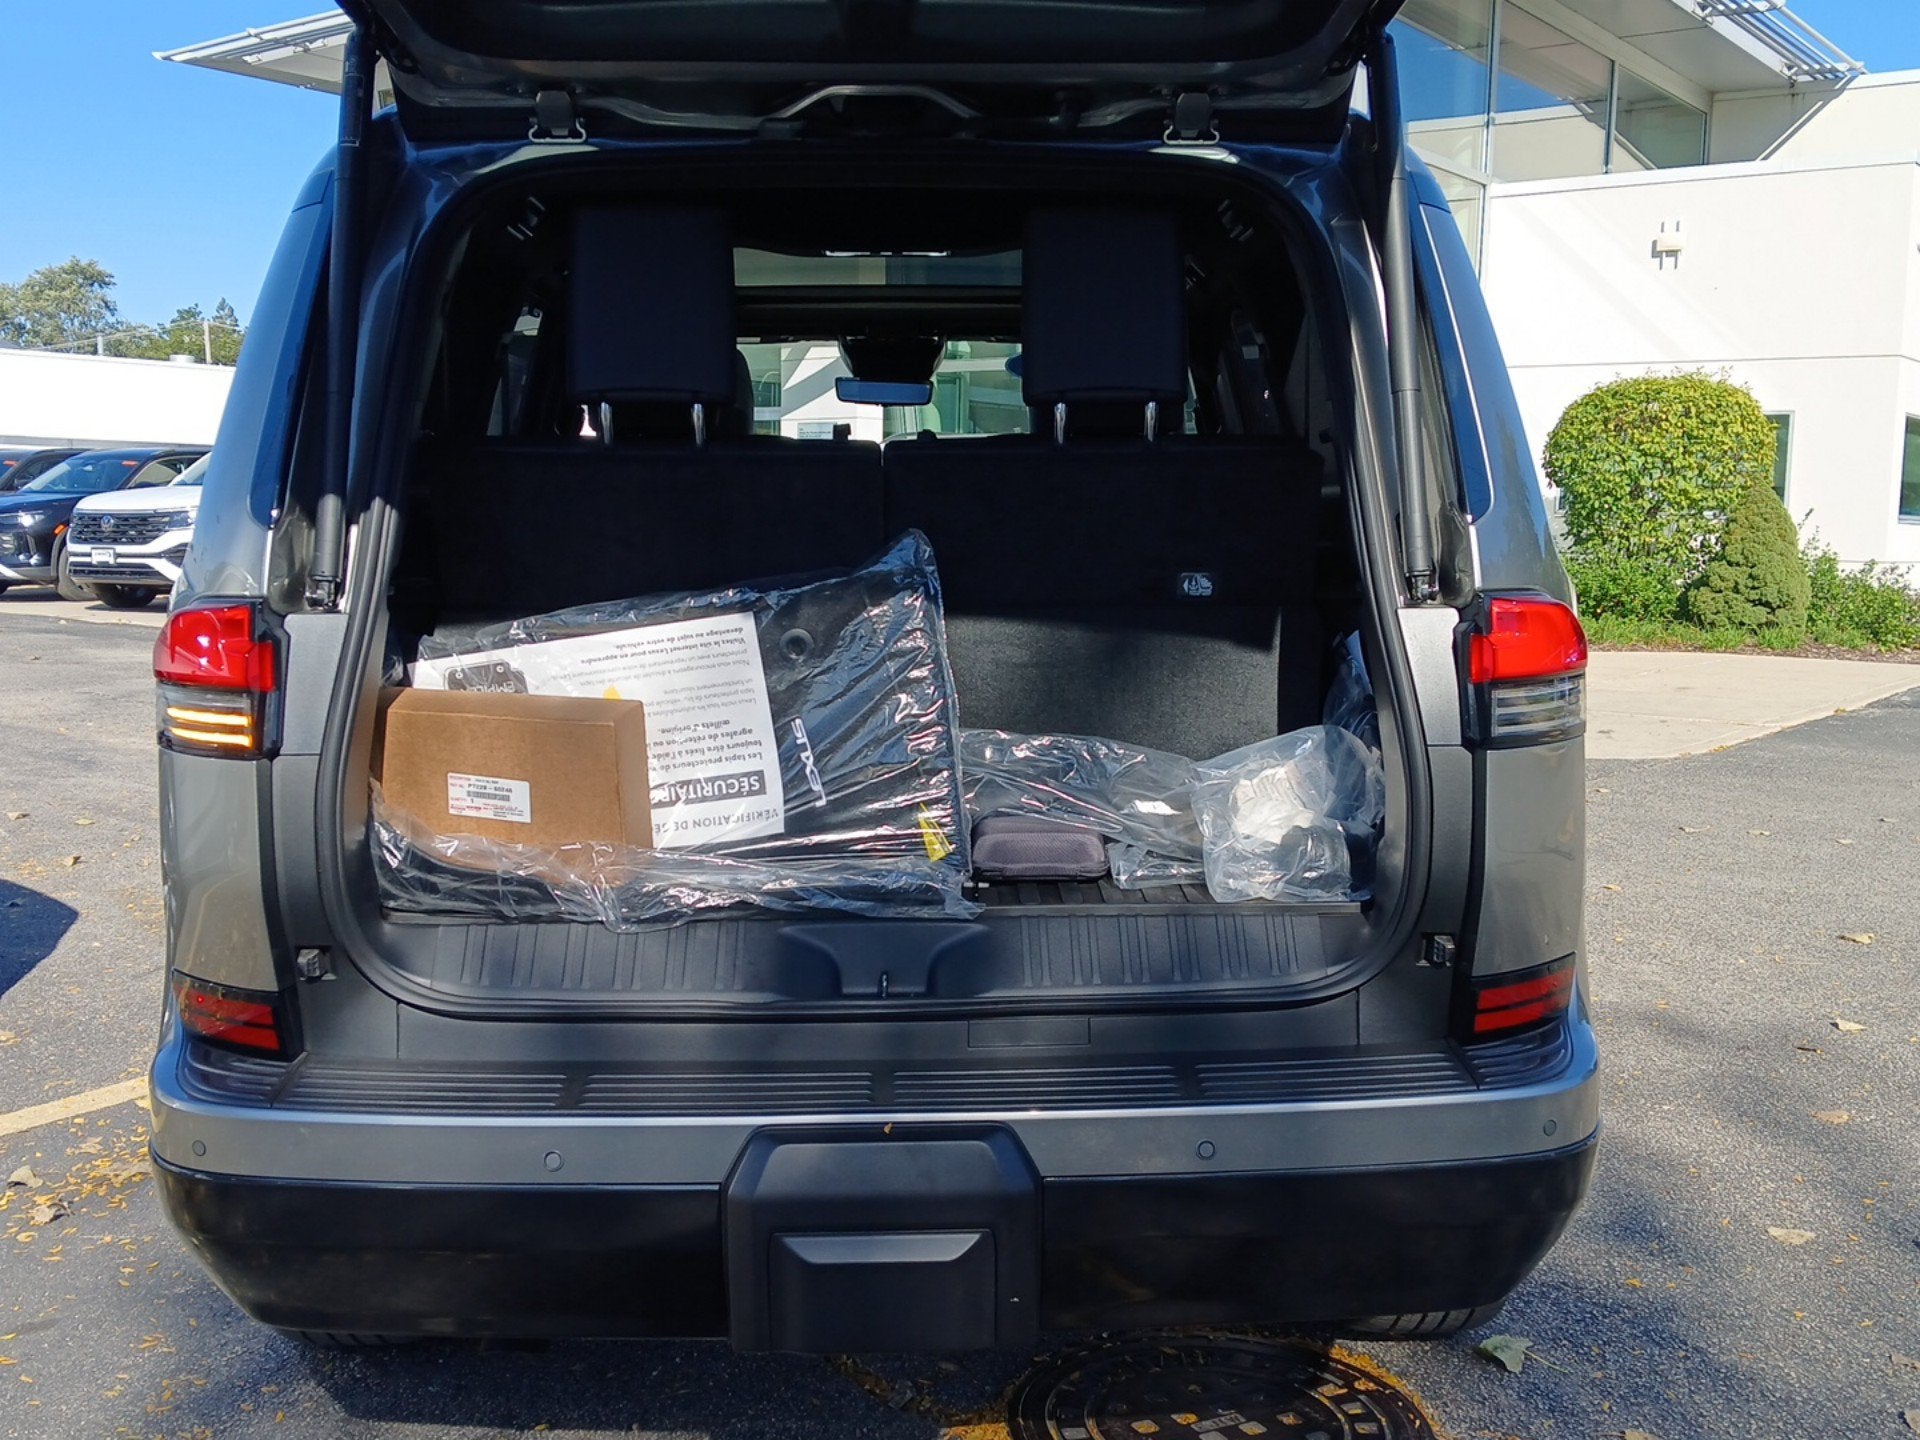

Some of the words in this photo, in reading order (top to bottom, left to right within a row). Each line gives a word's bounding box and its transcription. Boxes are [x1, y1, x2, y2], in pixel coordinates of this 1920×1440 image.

[706, 626, 743, 637] davantage
[666, 636, 675, 644] de
[676, 633, 693, 642] sujet
[722, 636, 745, 646] Visitez
[669, 643, 697, 653] internet
[699, 641, 711, 649] site
[647, 647, 667, 656] Lexus
[580, 654, 617, 666] apprendre
[707, 732, 718, 741] de
[720, 726, 752, 739] agrafes
[706, 744, 724, 753] être
[726, 738, 761, 750] toujours
[724, 752, 745, 764] tapis
[747, 751, 762, 761] Les
[672, 755, 722, 771] protecteurs
[791, 718, 827, 808] LEXUS
